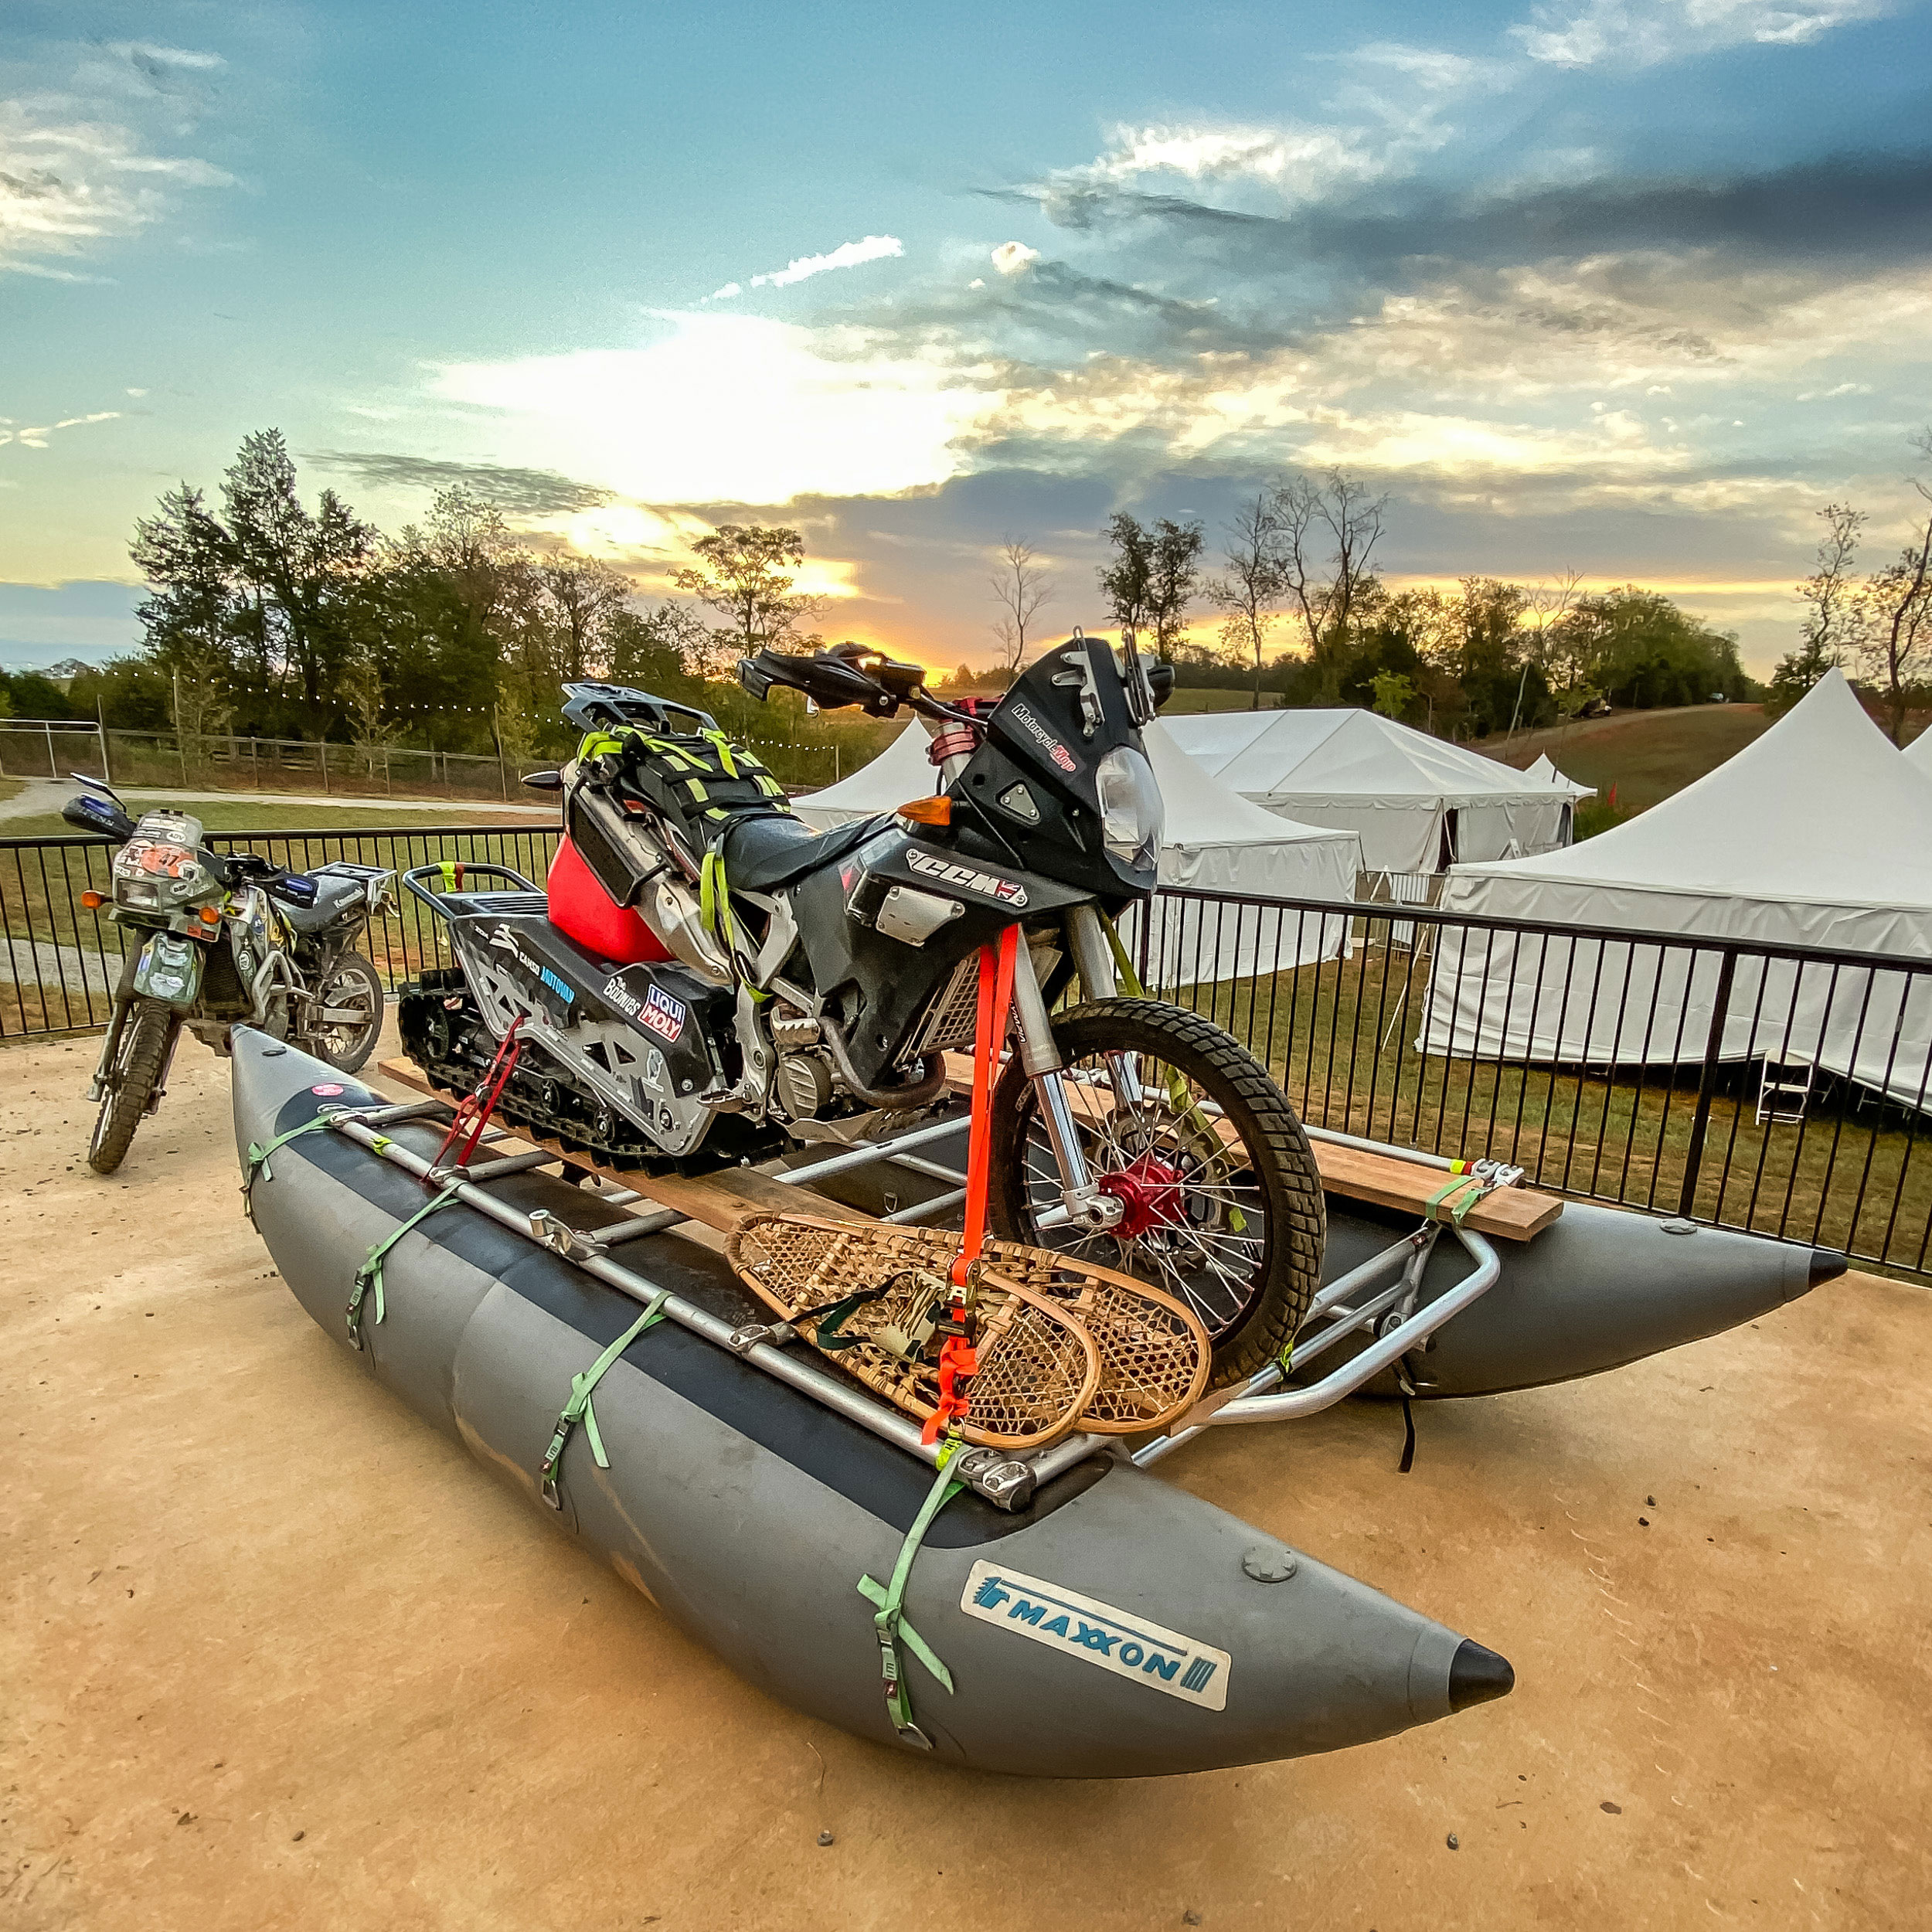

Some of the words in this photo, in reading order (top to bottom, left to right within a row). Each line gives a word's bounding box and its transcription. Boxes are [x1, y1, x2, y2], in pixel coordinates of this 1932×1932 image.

[913, 856, 1000, 896] CCM
[641, 1005, 681, 1038] MOLY
[649, 988, 683, 1022] LIQUI
[1008, 1599, 1181, 1682] MAXXON
